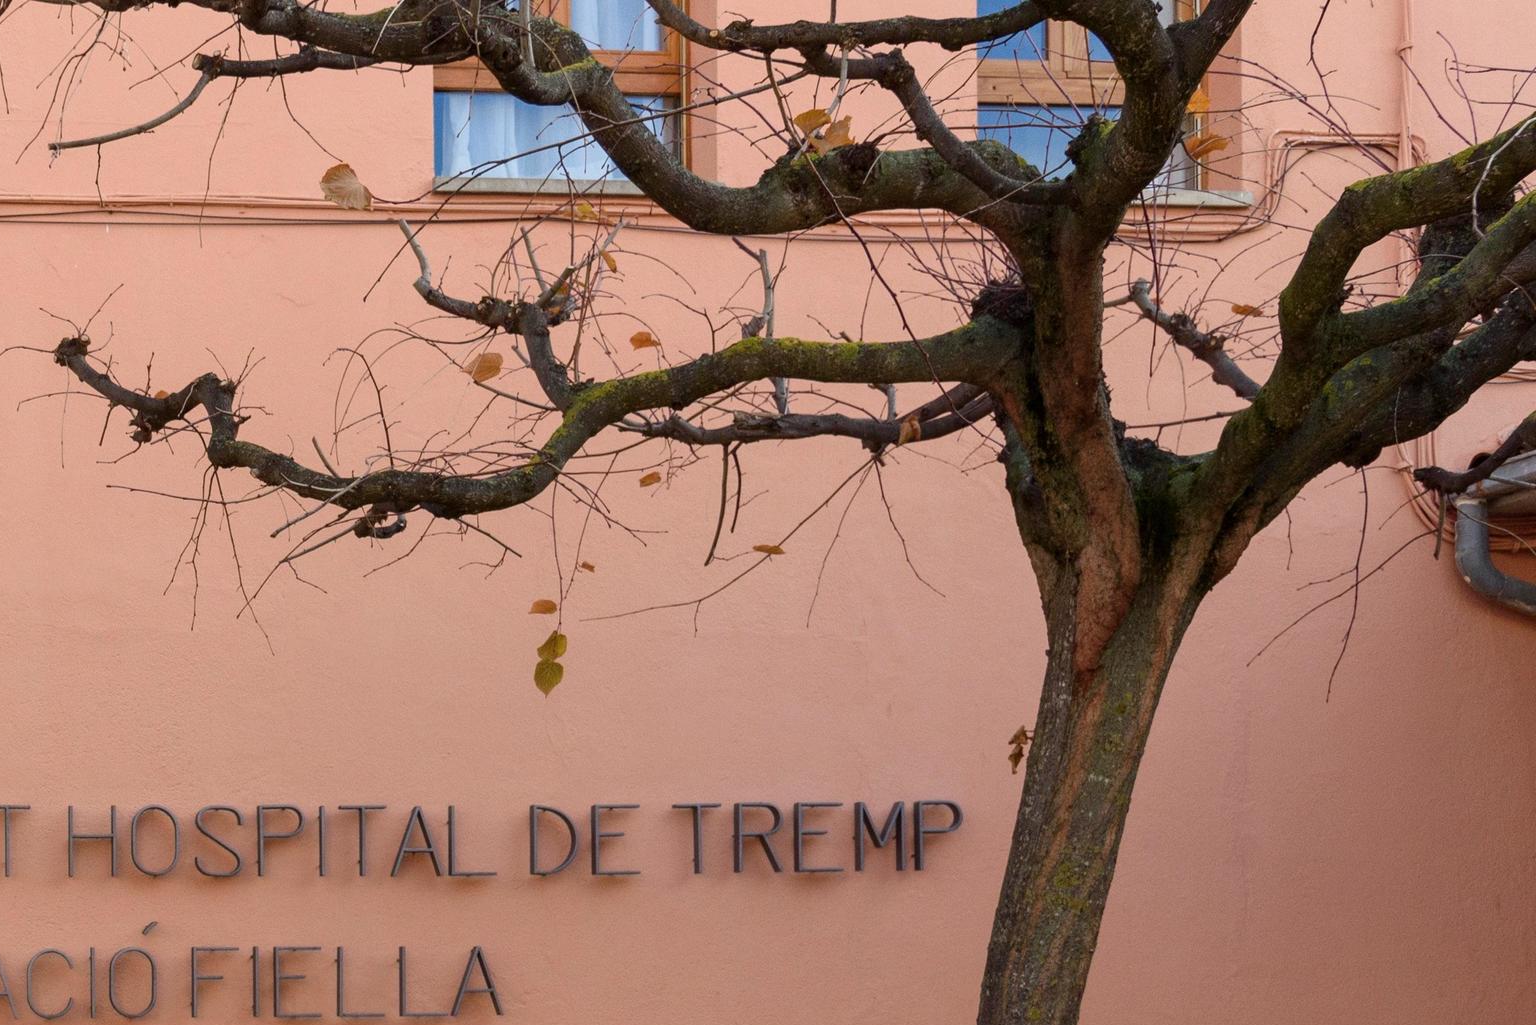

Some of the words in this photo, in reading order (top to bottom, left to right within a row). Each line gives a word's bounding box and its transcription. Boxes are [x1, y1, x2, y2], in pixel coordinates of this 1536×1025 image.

[67, 804, 498, 878] HOSPITAL
[529, 803, 641, 876] DE
[672, 801, 963, 874] TREMP
[191, 945, 504, 1018] FIELLA
